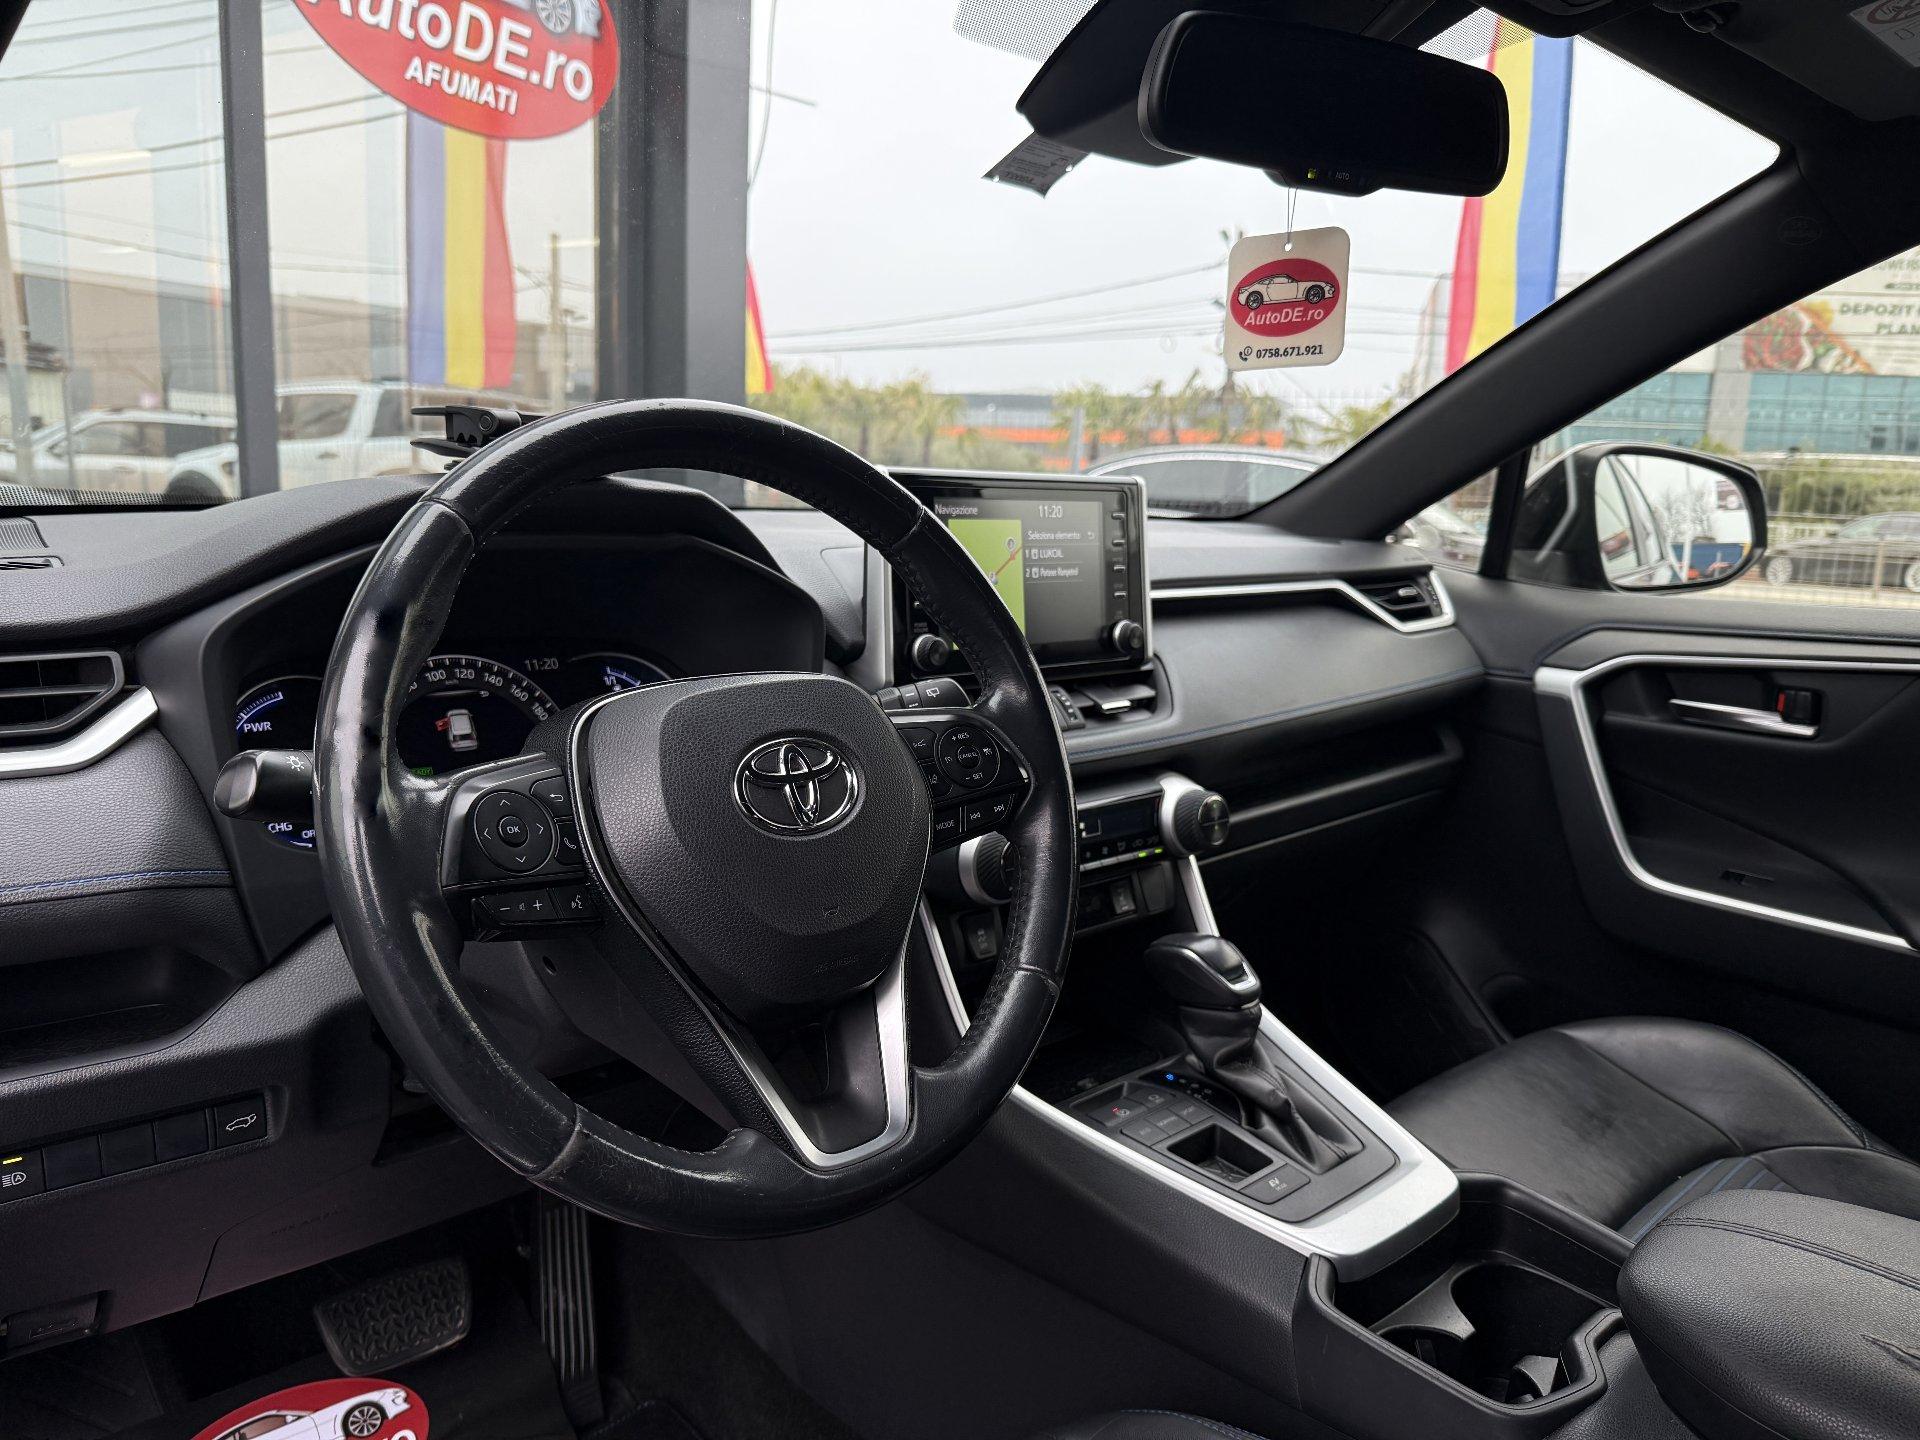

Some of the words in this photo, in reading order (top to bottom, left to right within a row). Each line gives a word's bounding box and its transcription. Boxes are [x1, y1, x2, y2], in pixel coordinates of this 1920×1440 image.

[1335, 171, 1350, 181] AUTO
[1840, 303, 1914, 316] DEPOZIT
[1244, 307, 1325, 326] AutoDE.ro
[1256, 344, 1324, 359] 0758.671.921
[934, 504, 978, 517] Navigazione
[1038, 505, 1063, 518] 11:20
[1025, 568, 1031, 578] 2
[525, 658, 559, 671] 11:20
[425, 670, 447, 682] 100
[455, 668, 475, 680] 120
[484, 672, 504, 688] 140
[510, 683, 529, 702] 160
[531, 702, 549, 722] 180
[243, 721, 272, 733] PWR
[972, 772, 983, 781] SET
[268, 822, 293, 834] CHG
[506, 825, 521, 834] OK
[935, 820, 955, 831] MODE
[1268, 1177, 1281, 1188] EV
